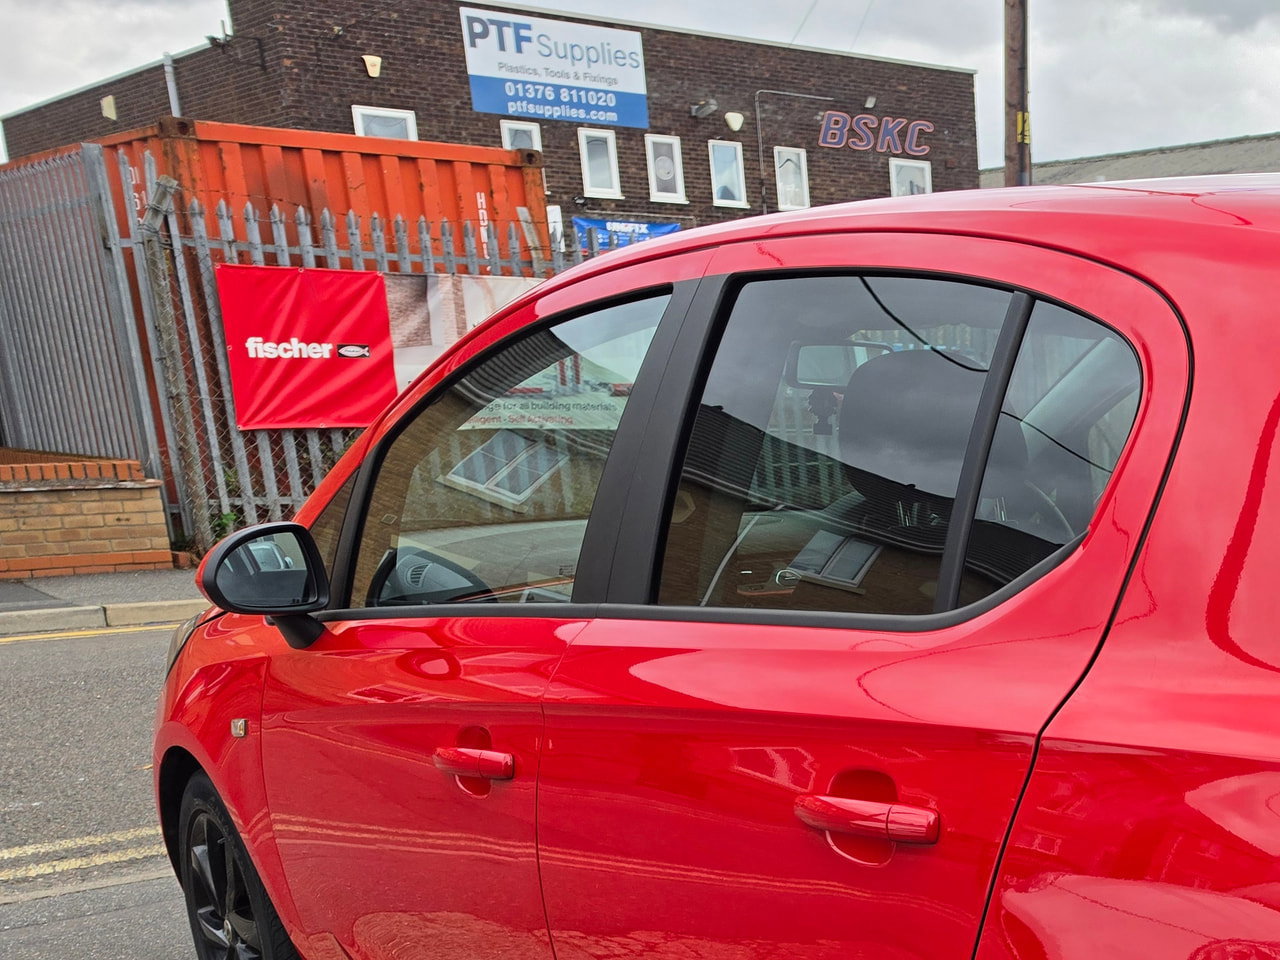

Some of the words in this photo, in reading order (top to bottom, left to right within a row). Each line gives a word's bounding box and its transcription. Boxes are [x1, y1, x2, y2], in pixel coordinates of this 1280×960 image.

[466, 15, 532, 54] PTF
[537, 33, 640, 69] Supplies
[498, 62, 541, 77] Plastics,
[544, 67, 570, 80] Tools
[573, 71, 580, 81] &
[583, 72, 618, 86] Fixings
[504, 82, 555, 100] 01376
[560, 88, 616, 107] 811020
[507, 100, 618, 121] ptfsupplies.com
[818, 110, 935, 155] BSKC
[245, 336, 333, 359] fischer
[503, 401, 517, 410] for
[531, 401, 570, 412] building
